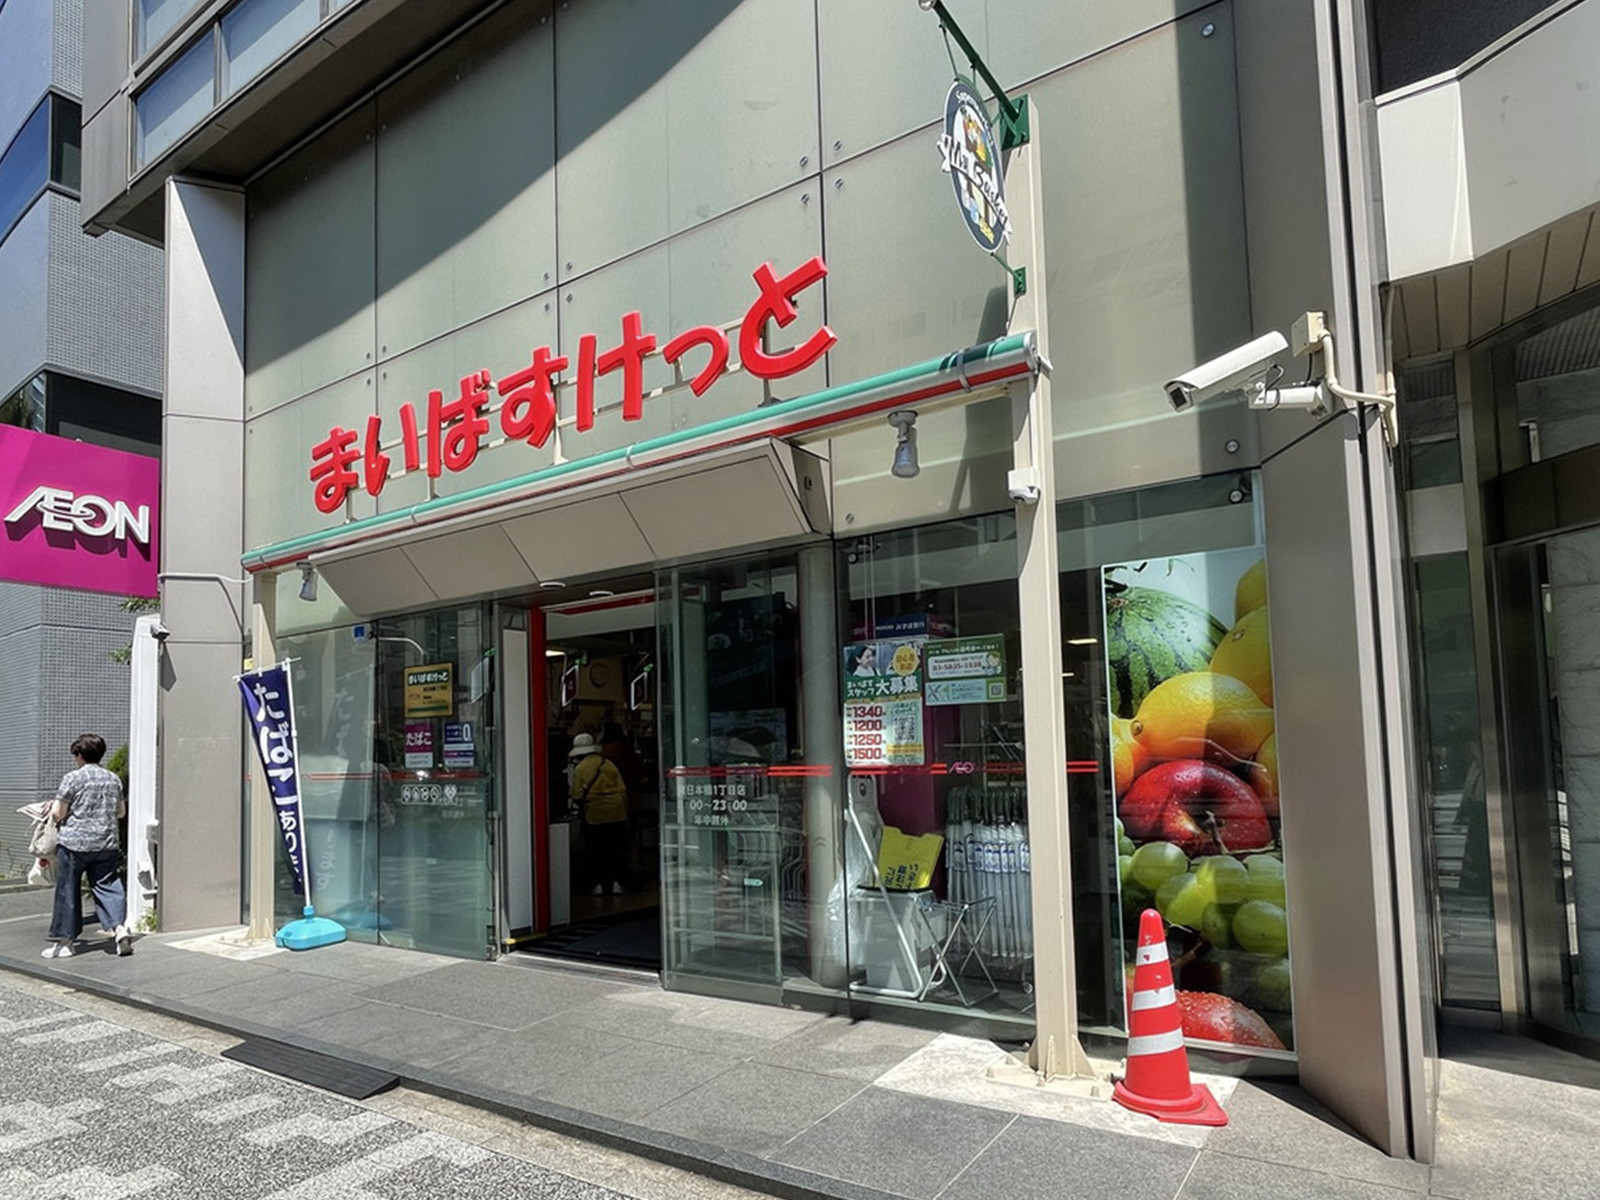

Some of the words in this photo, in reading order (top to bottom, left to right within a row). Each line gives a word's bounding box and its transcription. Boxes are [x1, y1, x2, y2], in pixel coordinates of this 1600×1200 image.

[310, 256, 838, 514] まいばすけっと
[4, 485, 149, 544] AEON
[847, 688, 875, 697] スタッフ
[875, 675, 918, 696] 大募集
[406, 731, 432, 746] たばこ
[948, 761, 976, 775] AEO
